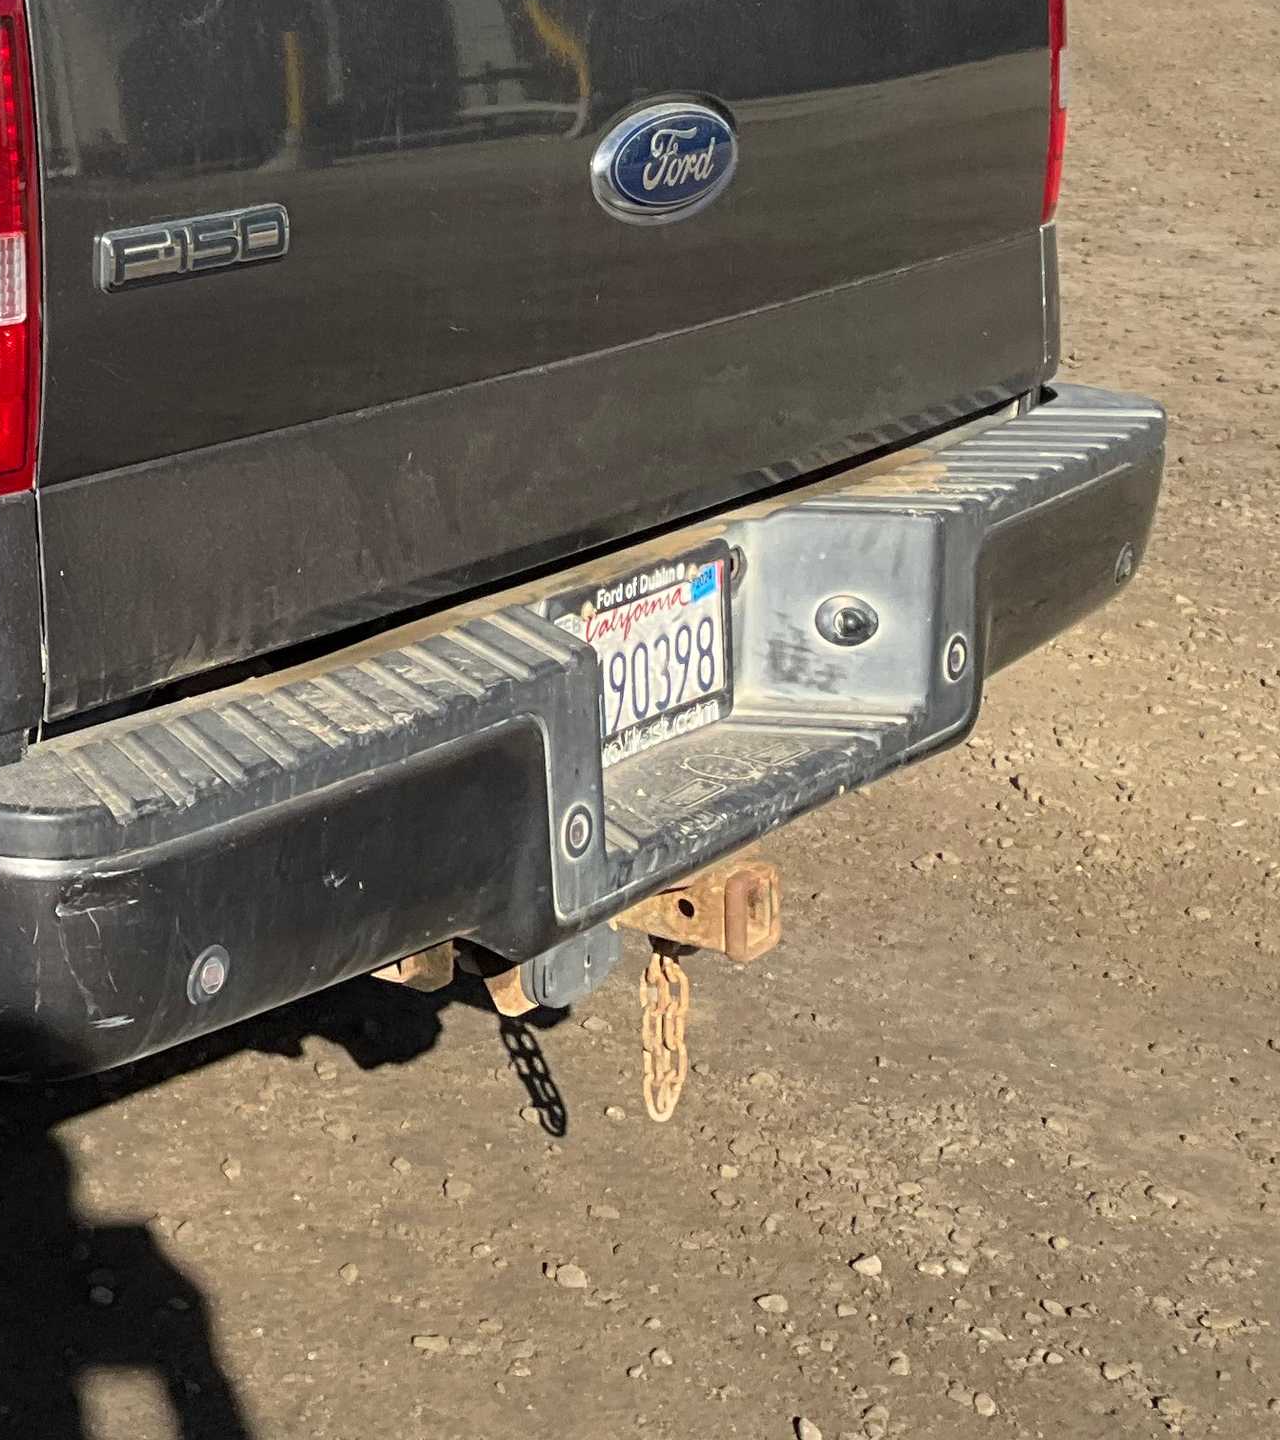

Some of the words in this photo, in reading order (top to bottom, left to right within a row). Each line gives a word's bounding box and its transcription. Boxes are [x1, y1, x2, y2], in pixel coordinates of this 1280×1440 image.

[642, 126, 715, 191] Ford
[586, 585, 690, 642] California
[596, 582, 623, 609] Ford
[625, 576, 638, 599] of
[640, 566, 675, 594] Dublin
[600, 616, 715, 736] 90398
